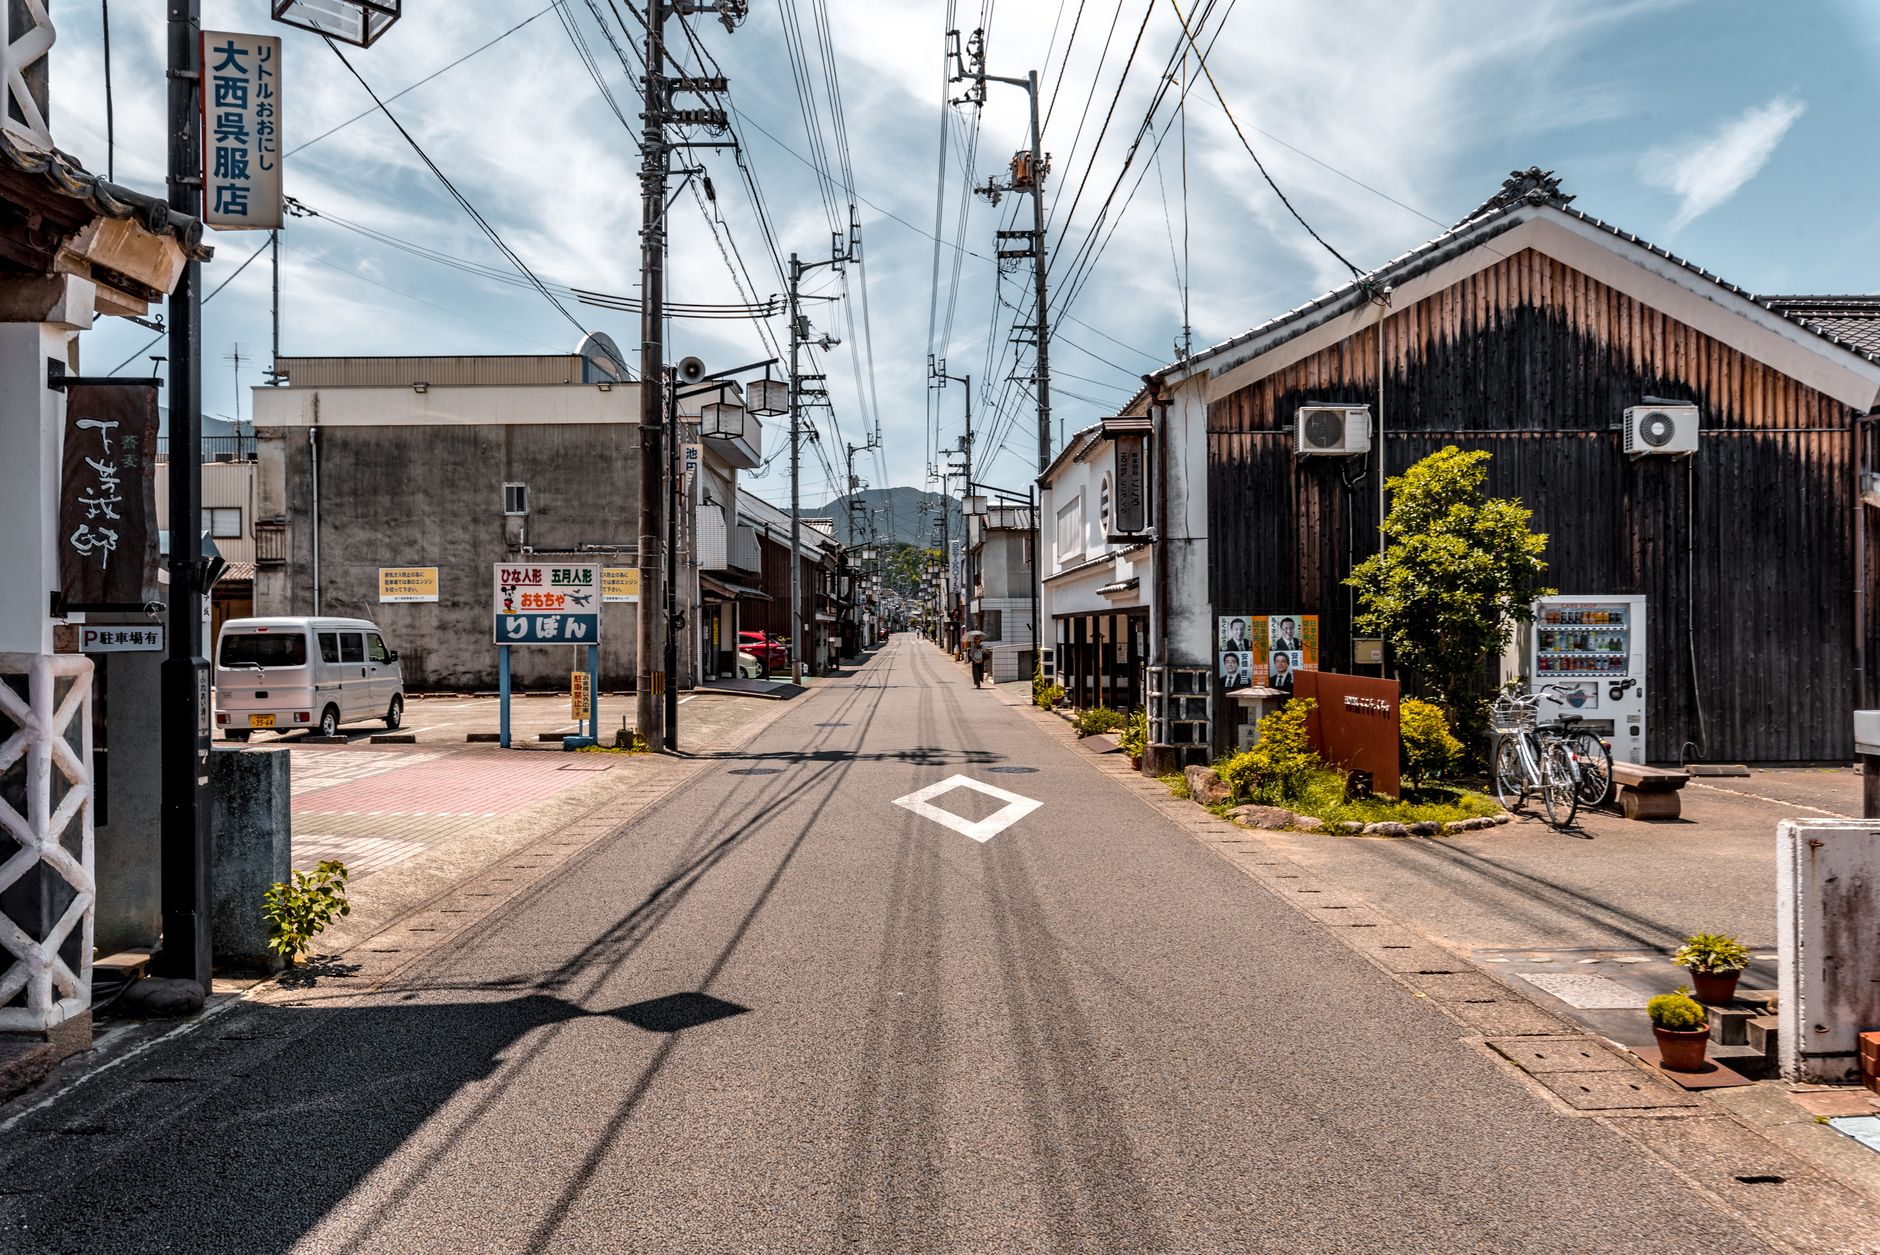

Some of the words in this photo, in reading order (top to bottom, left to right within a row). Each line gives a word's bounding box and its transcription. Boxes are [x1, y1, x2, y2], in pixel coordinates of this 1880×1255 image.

[256, 45, 275, 171] リトルおおにし
[212, 40, 251, 216] 大西呉服店
[501, 569, 542, 583] ひな人形
[551, 569, 592, 583] 五月人形
[521, 592, 565, 607] おもちゃ
[506, 615, 587, 639] りぼん
